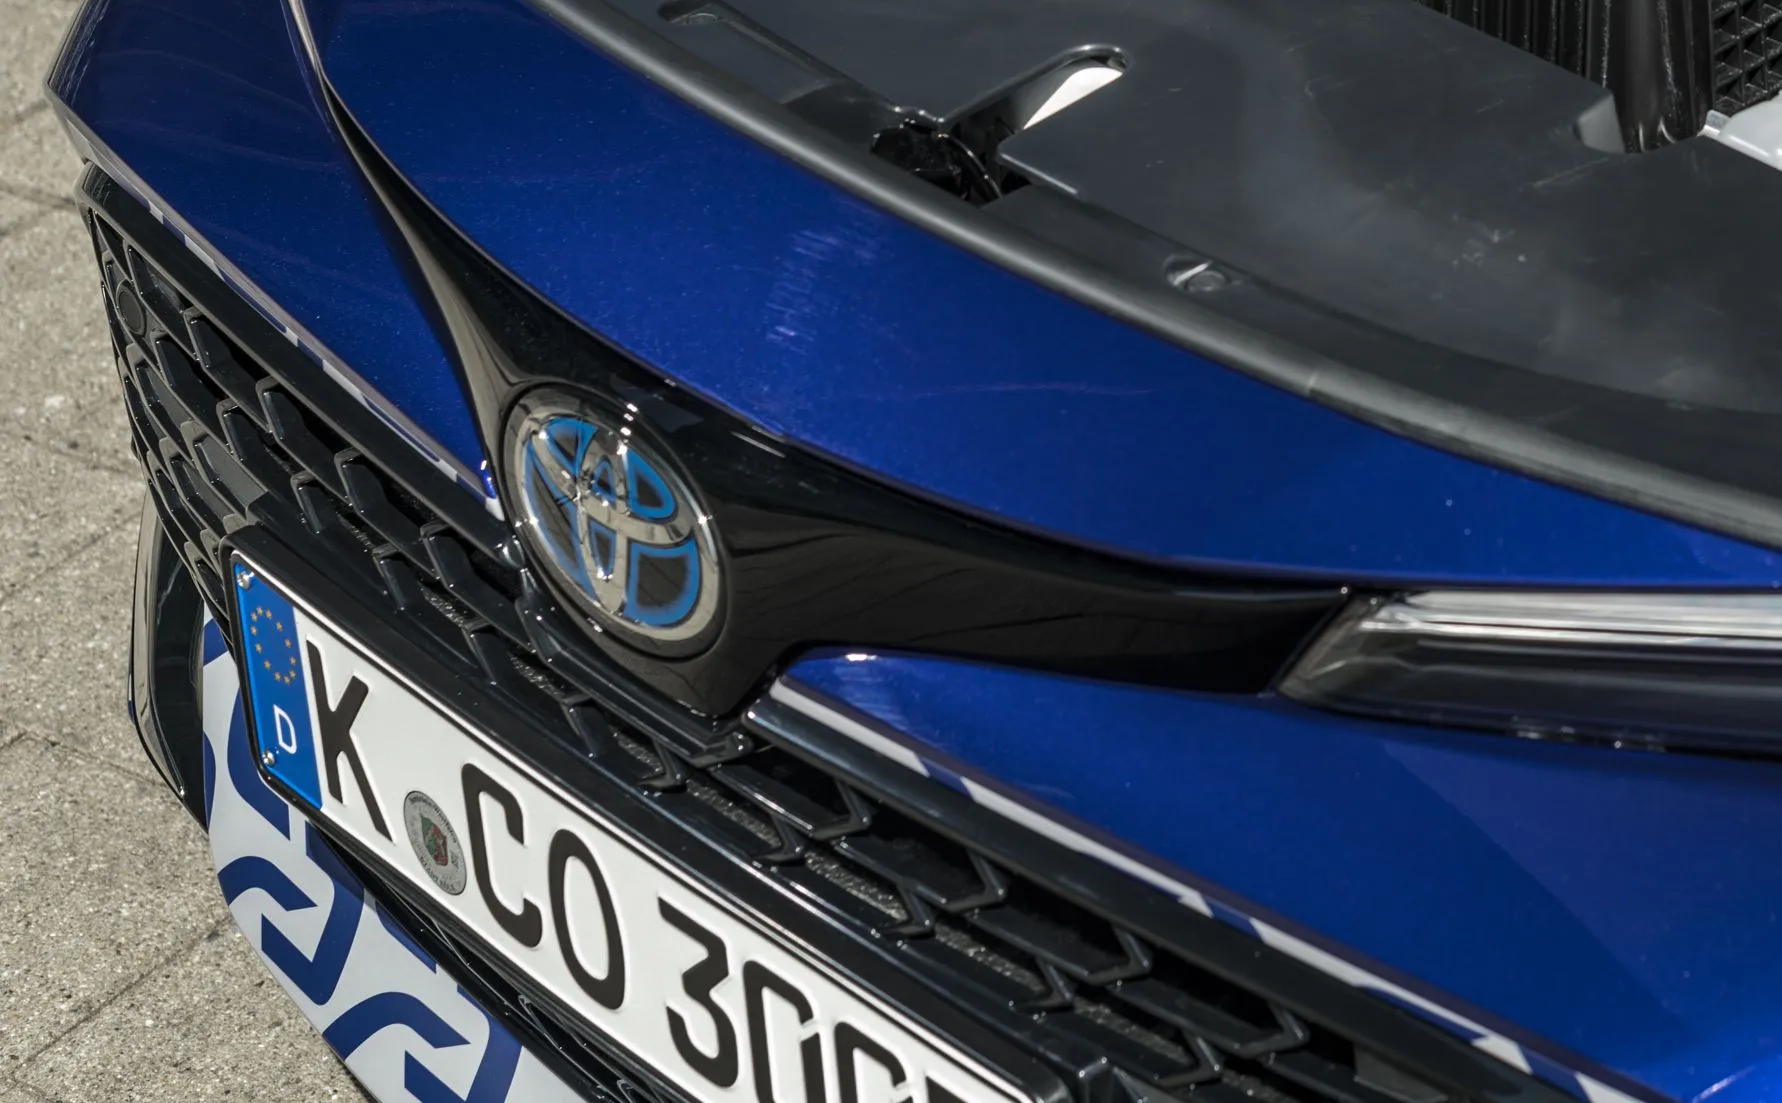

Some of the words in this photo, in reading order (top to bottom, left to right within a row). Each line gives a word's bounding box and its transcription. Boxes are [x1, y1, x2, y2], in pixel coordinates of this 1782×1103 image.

[273, 704, 297, 754] D
[305, 637, 395, 844] K
[460, 762, 627, 1011] CO
